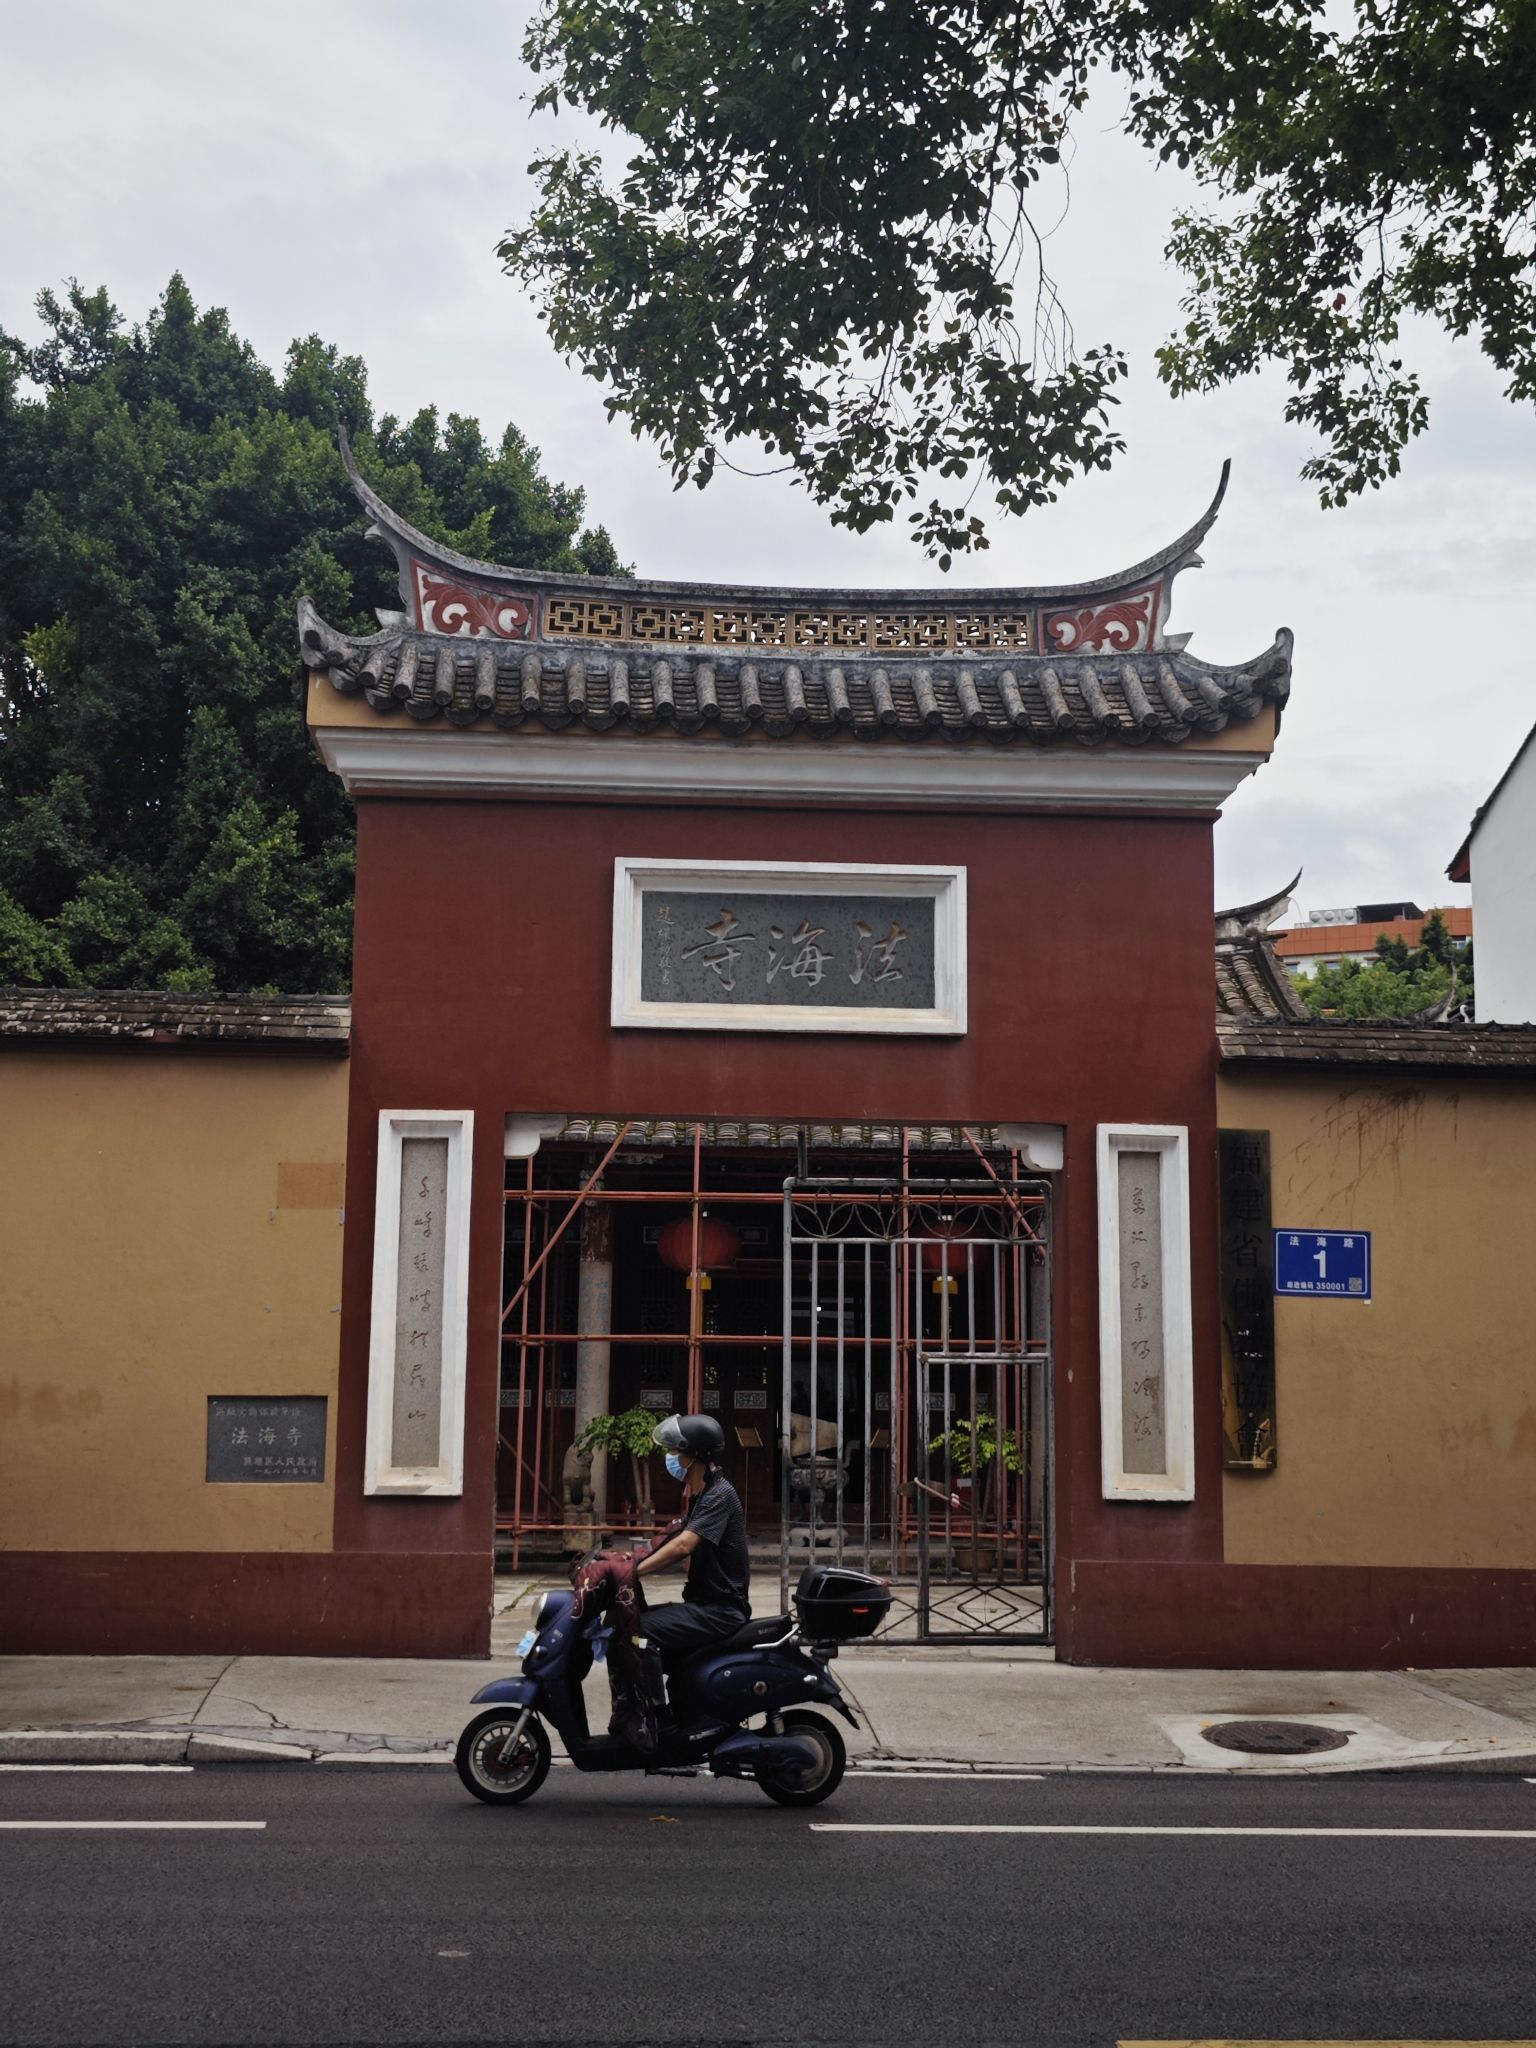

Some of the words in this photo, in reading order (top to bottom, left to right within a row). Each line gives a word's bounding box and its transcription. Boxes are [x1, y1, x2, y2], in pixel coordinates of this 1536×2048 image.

[681, 908, 908, 992] 法海寺
[1289, 1235, 1354, 1249] 法海路
[1313, 1250, 1327, 1278] 1
[1315, 1282, 1345, 1291] 350001
[231, 1426, 304, 1446] 法海寺
